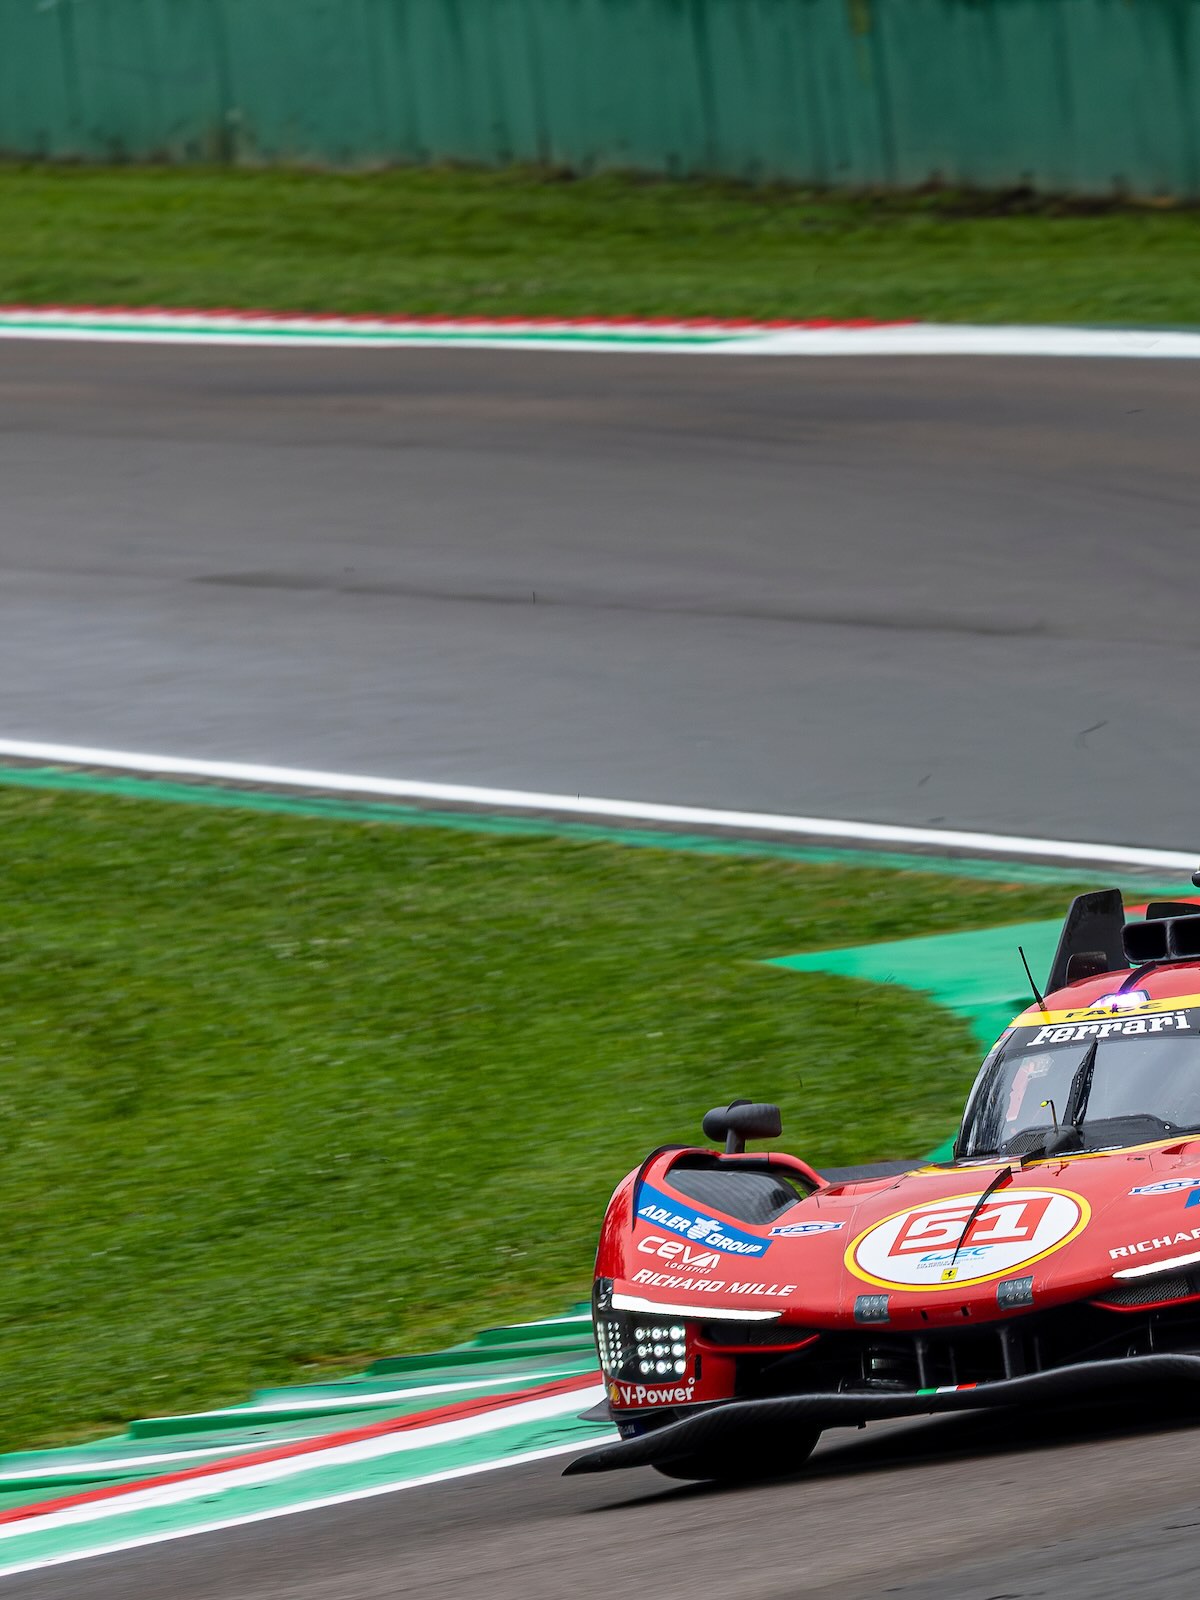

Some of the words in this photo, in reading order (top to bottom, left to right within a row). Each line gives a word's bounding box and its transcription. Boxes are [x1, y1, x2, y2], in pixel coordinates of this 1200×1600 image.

[1026, 1009, 1191, 1047] Ferrari
[637, 1203, 691, 1233] ADLER
[704, 1232, 763, 1255] GROUP
[899, 1202, 1029, 1250] 51
[631, 1268, 726, 1293] RICHARD
[724, 1281, 798, 1297] MILLE
[665, 1260, 712, 1274] LOGISTICS
[620, 1384, 695, 1405] V-Power
